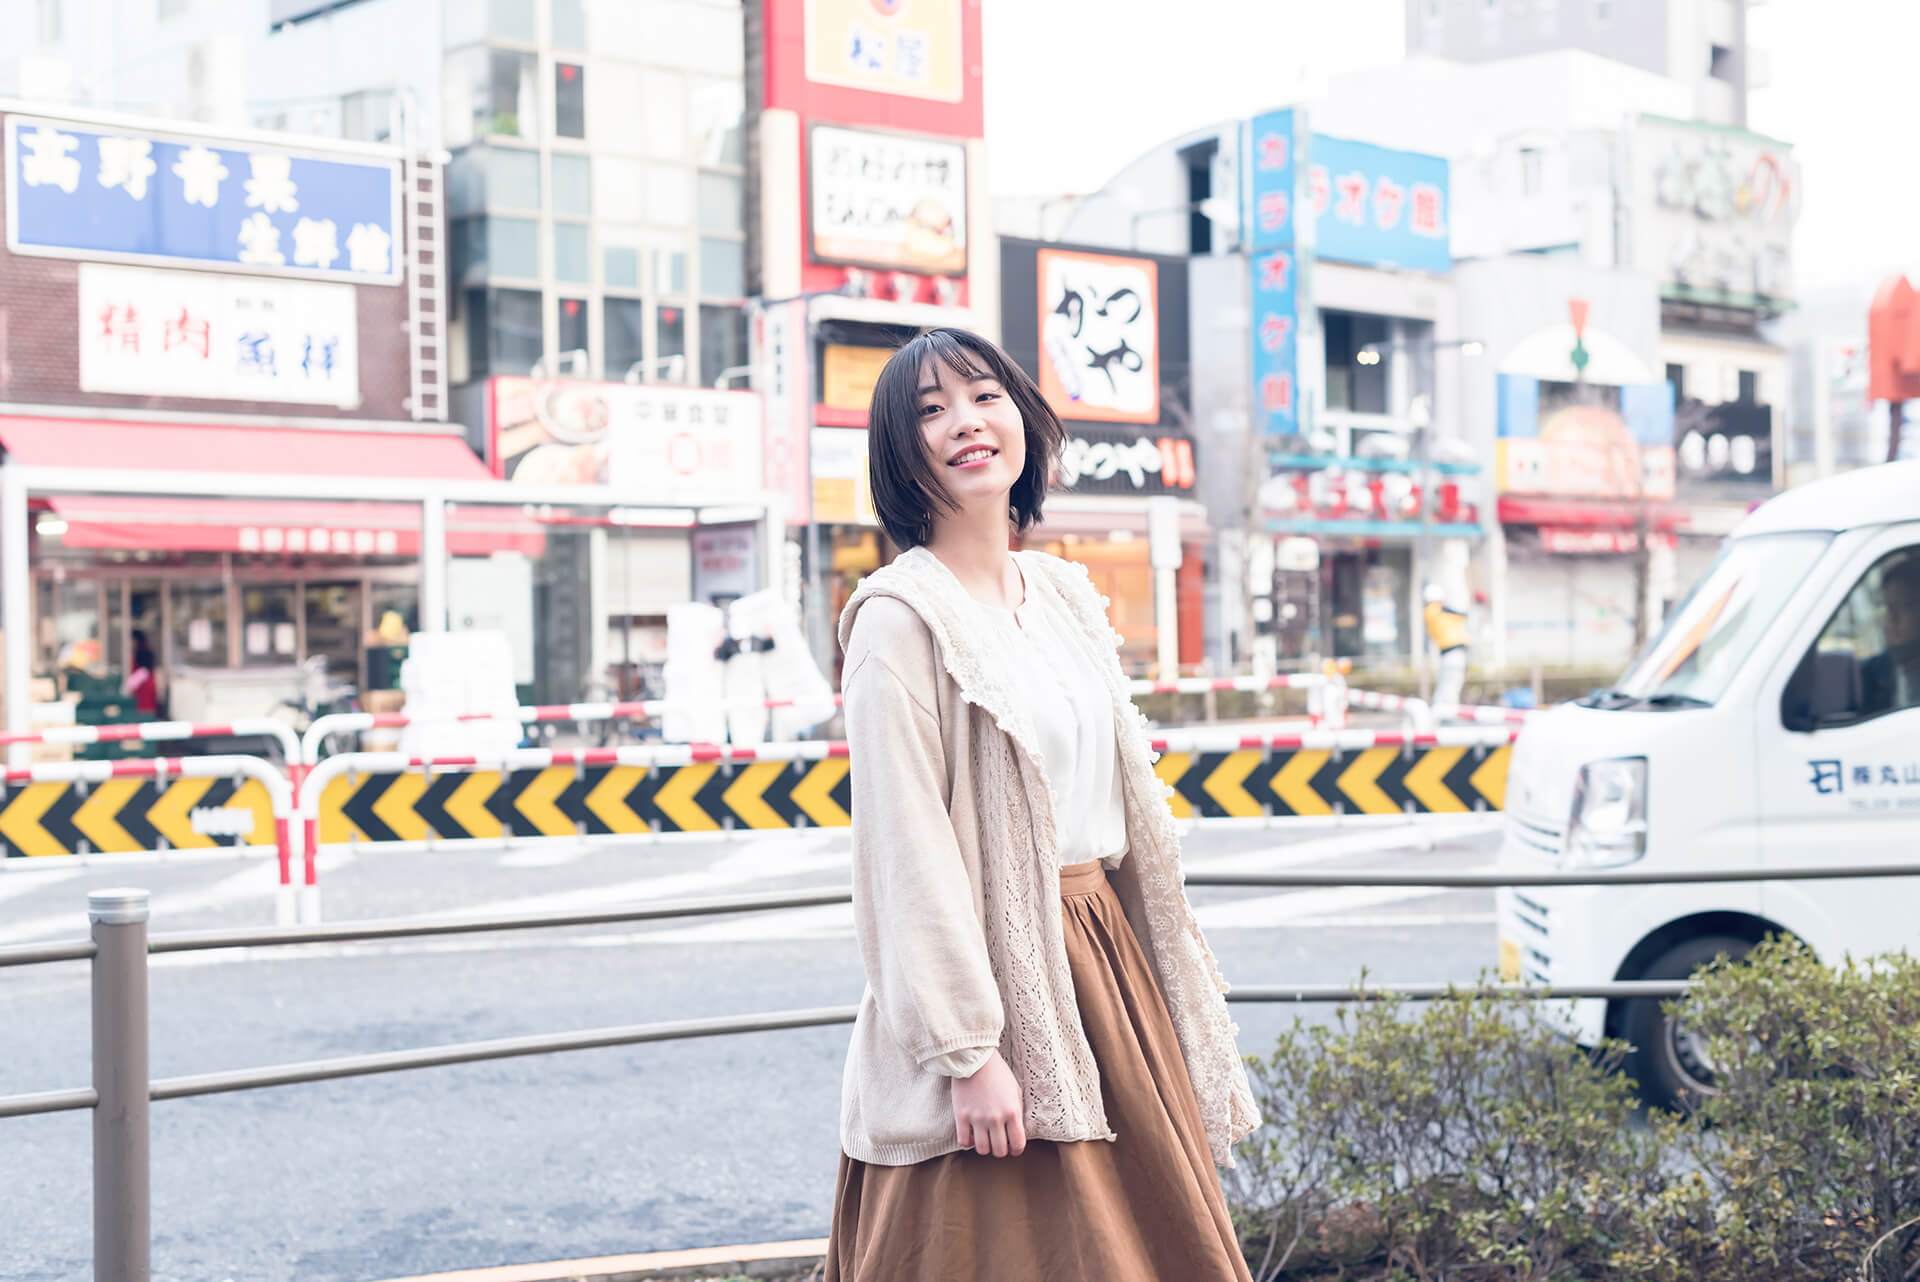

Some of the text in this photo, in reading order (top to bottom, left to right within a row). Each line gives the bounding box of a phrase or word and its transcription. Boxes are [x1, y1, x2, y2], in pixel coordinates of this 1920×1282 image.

[19, 128, 299, 214] 高野青果
[97, 301, 212, 359] 精肉
